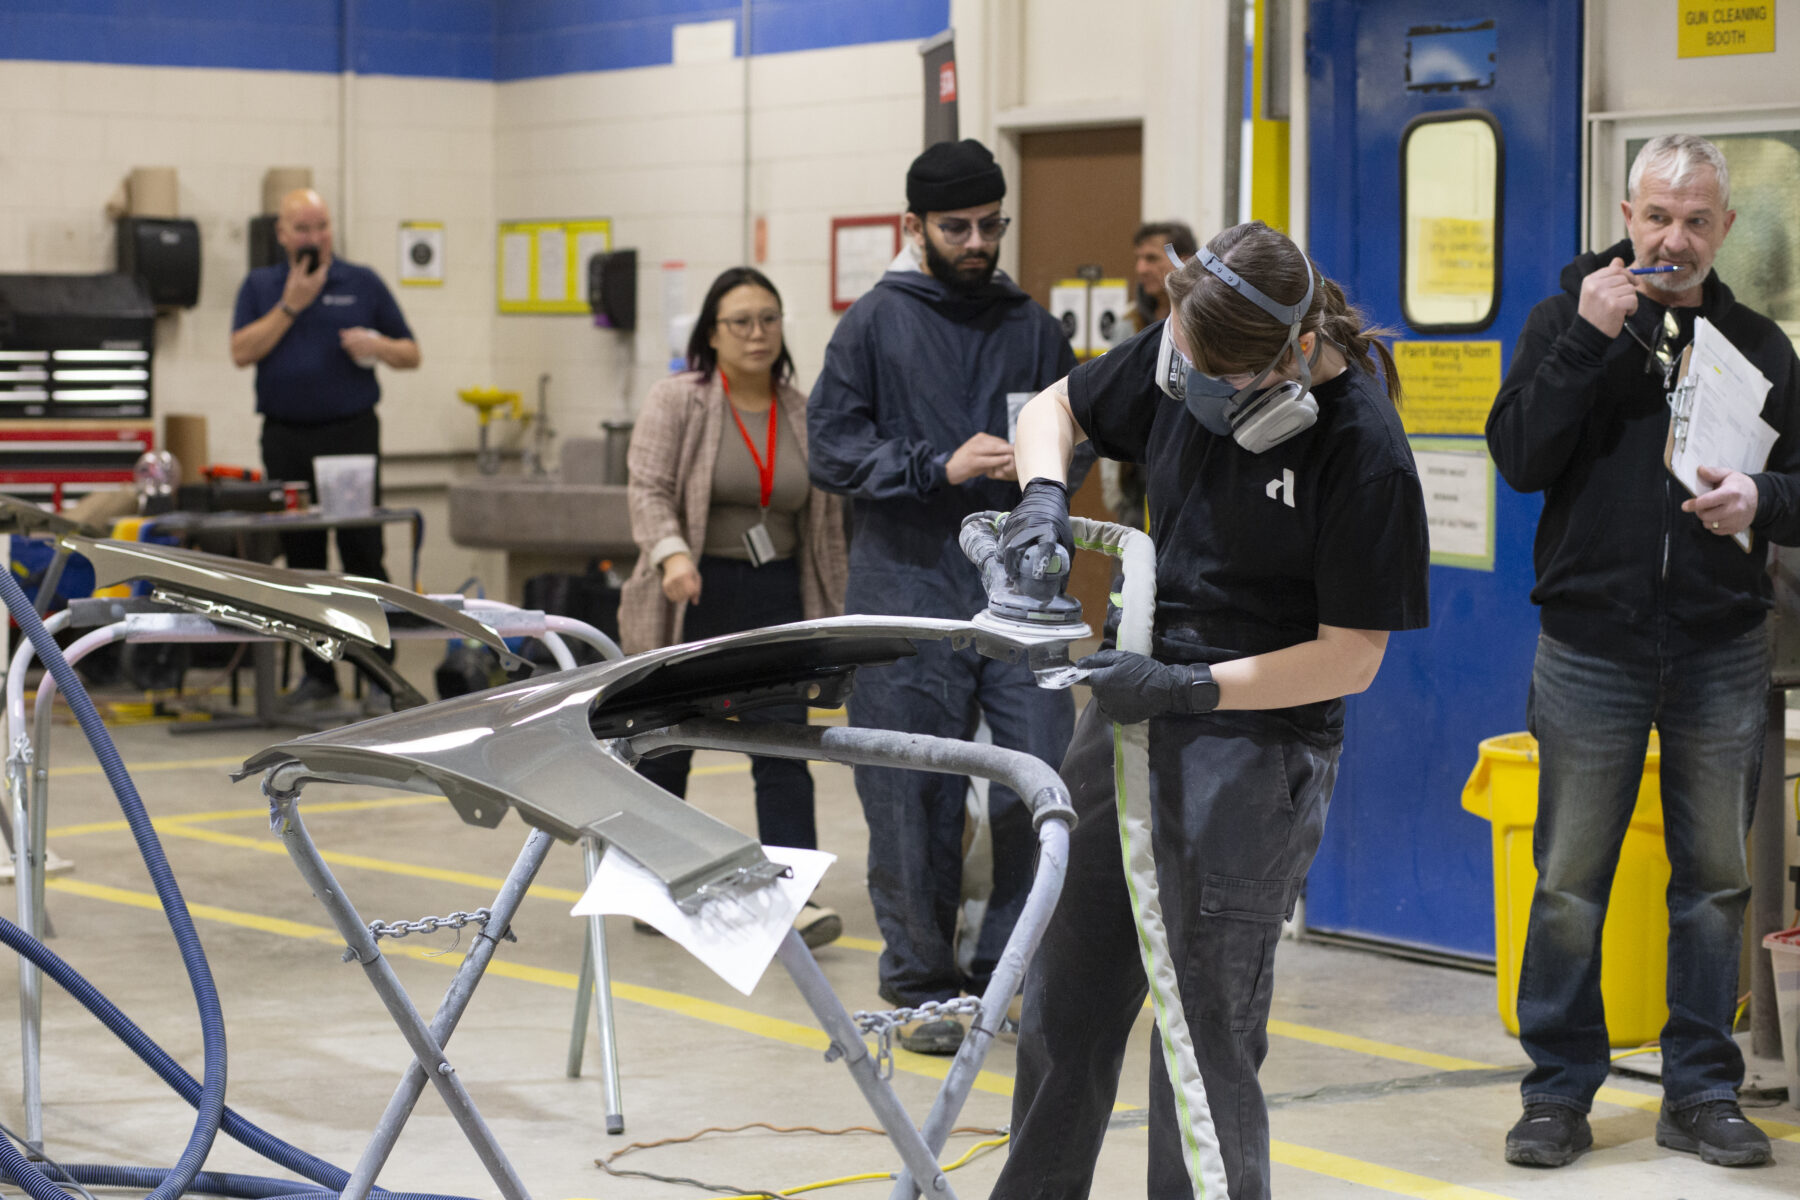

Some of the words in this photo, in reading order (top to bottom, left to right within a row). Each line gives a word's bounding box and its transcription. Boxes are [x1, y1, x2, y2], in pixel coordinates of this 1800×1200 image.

[1685, 10, 1708, 26] GUN
[1713, 6, 1767, 23] CLEANING
[1706, 30, 1746, 46] BOOTH
[1401, 344, 1426, 358] Paint
[1462, 343, 1493, 358] Room
